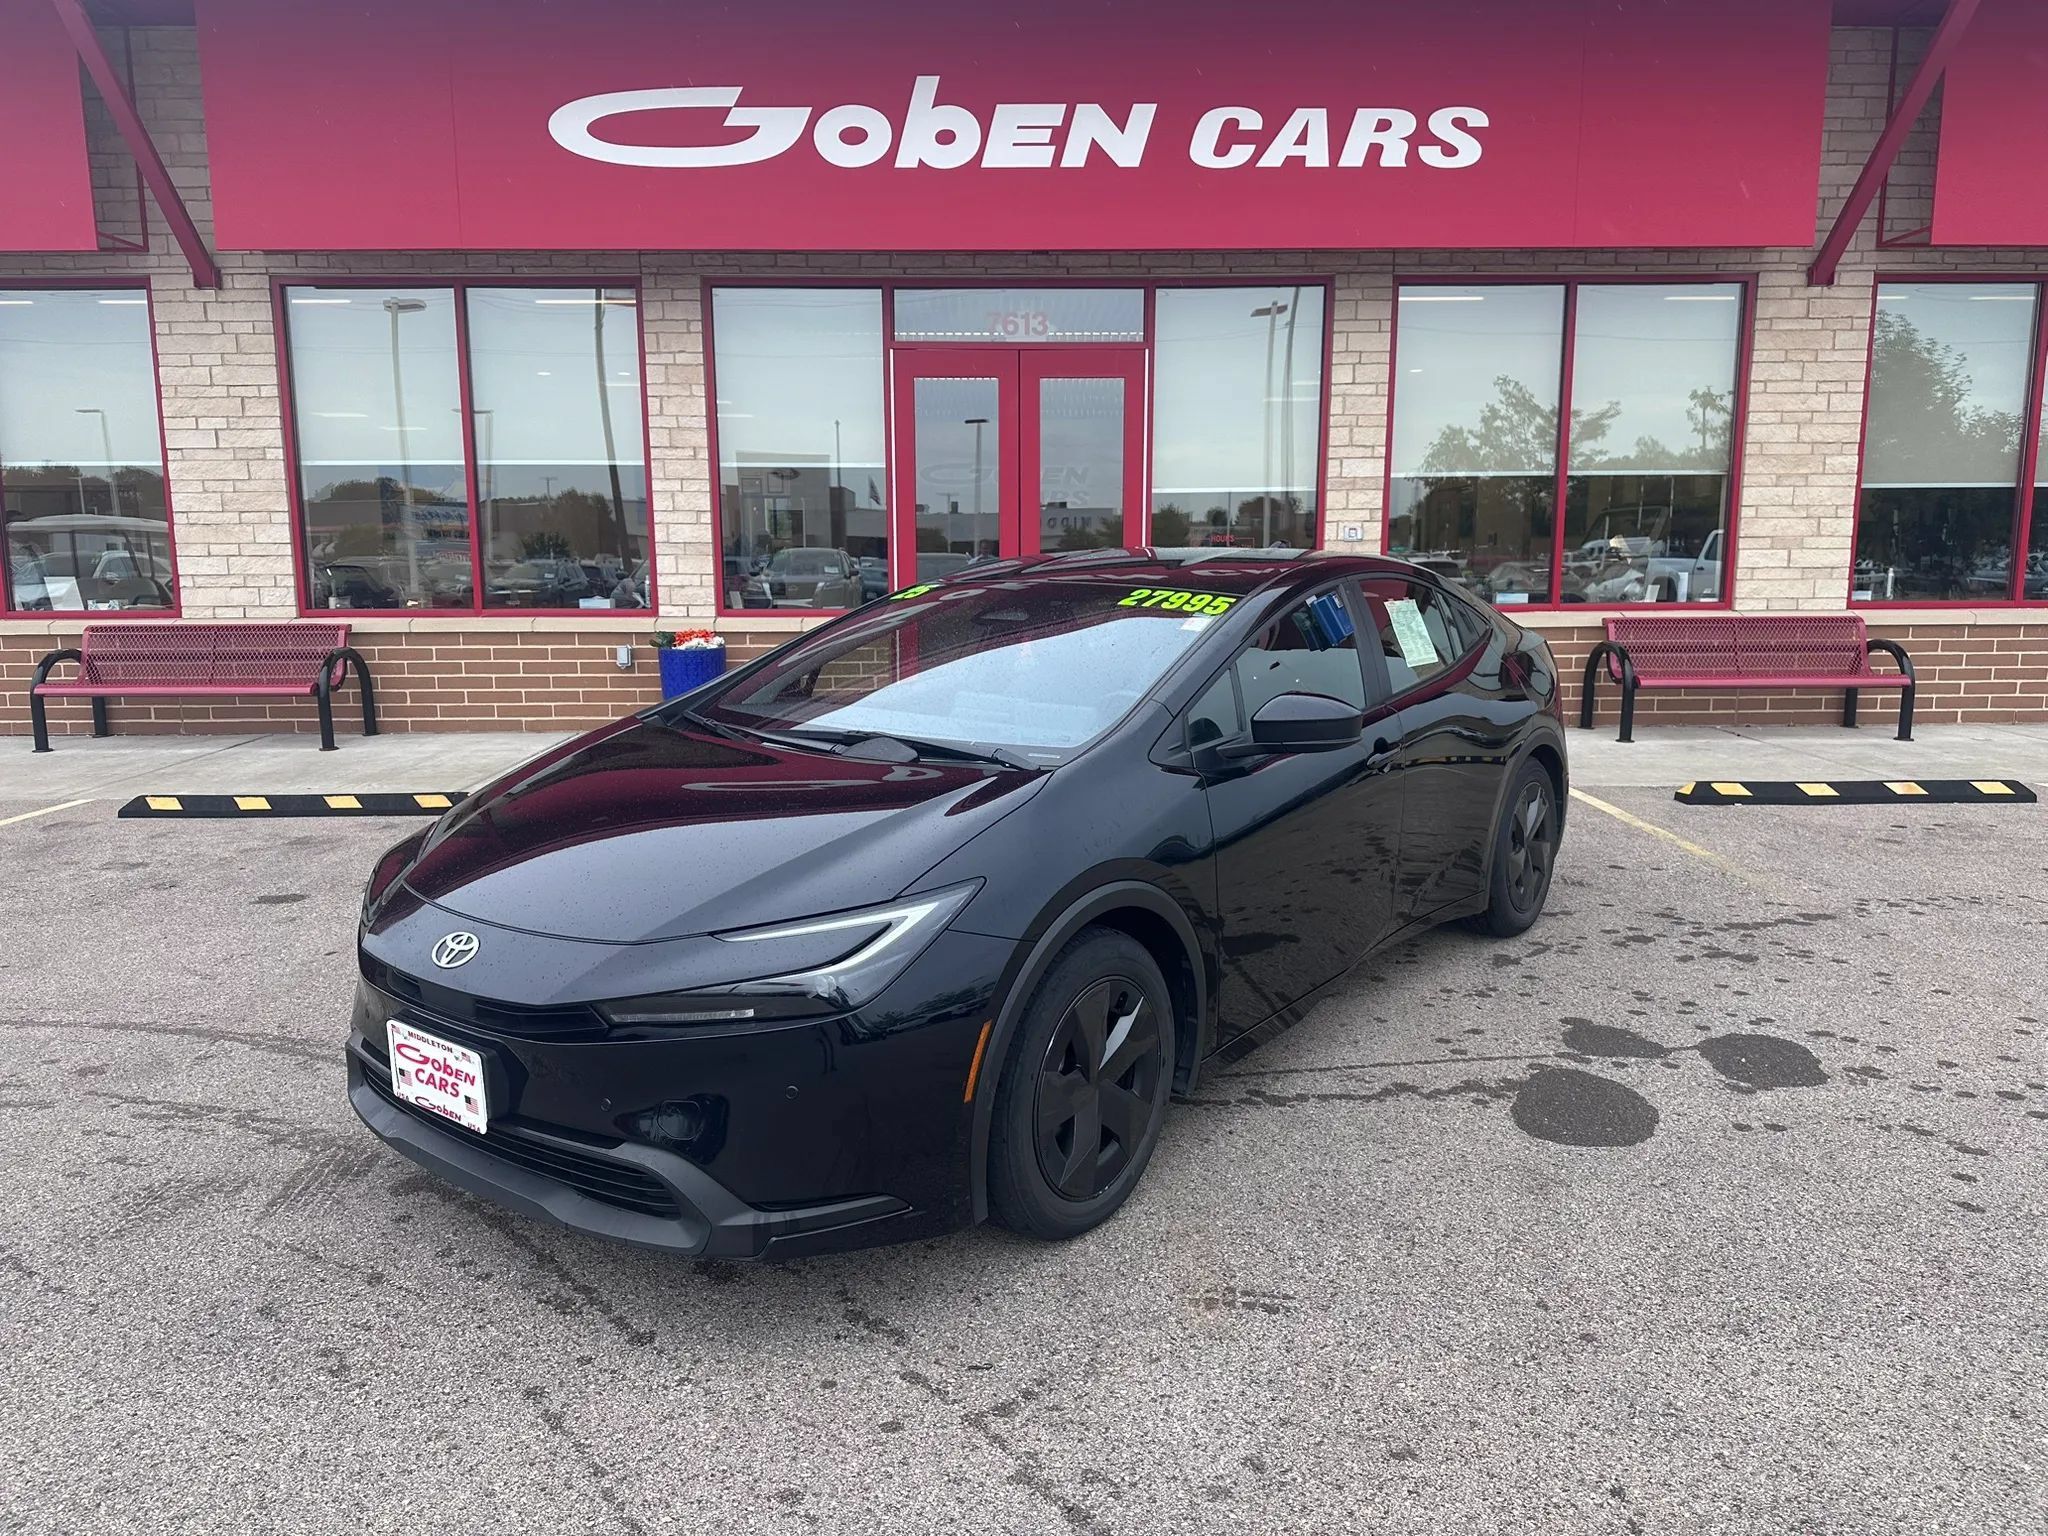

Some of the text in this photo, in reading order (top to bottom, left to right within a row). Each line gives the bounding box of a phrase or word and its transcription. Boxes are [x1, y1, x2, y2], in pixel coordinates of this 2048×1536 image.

[1188, 106, 1490, 169] CARS
[986, 311, 1049, 336] 7613
[1117, 588, 1237, 615] 27995
[407, 1030, 454, 1054] MIDDLETON
[414, 1068, 461, 1098] CARS
